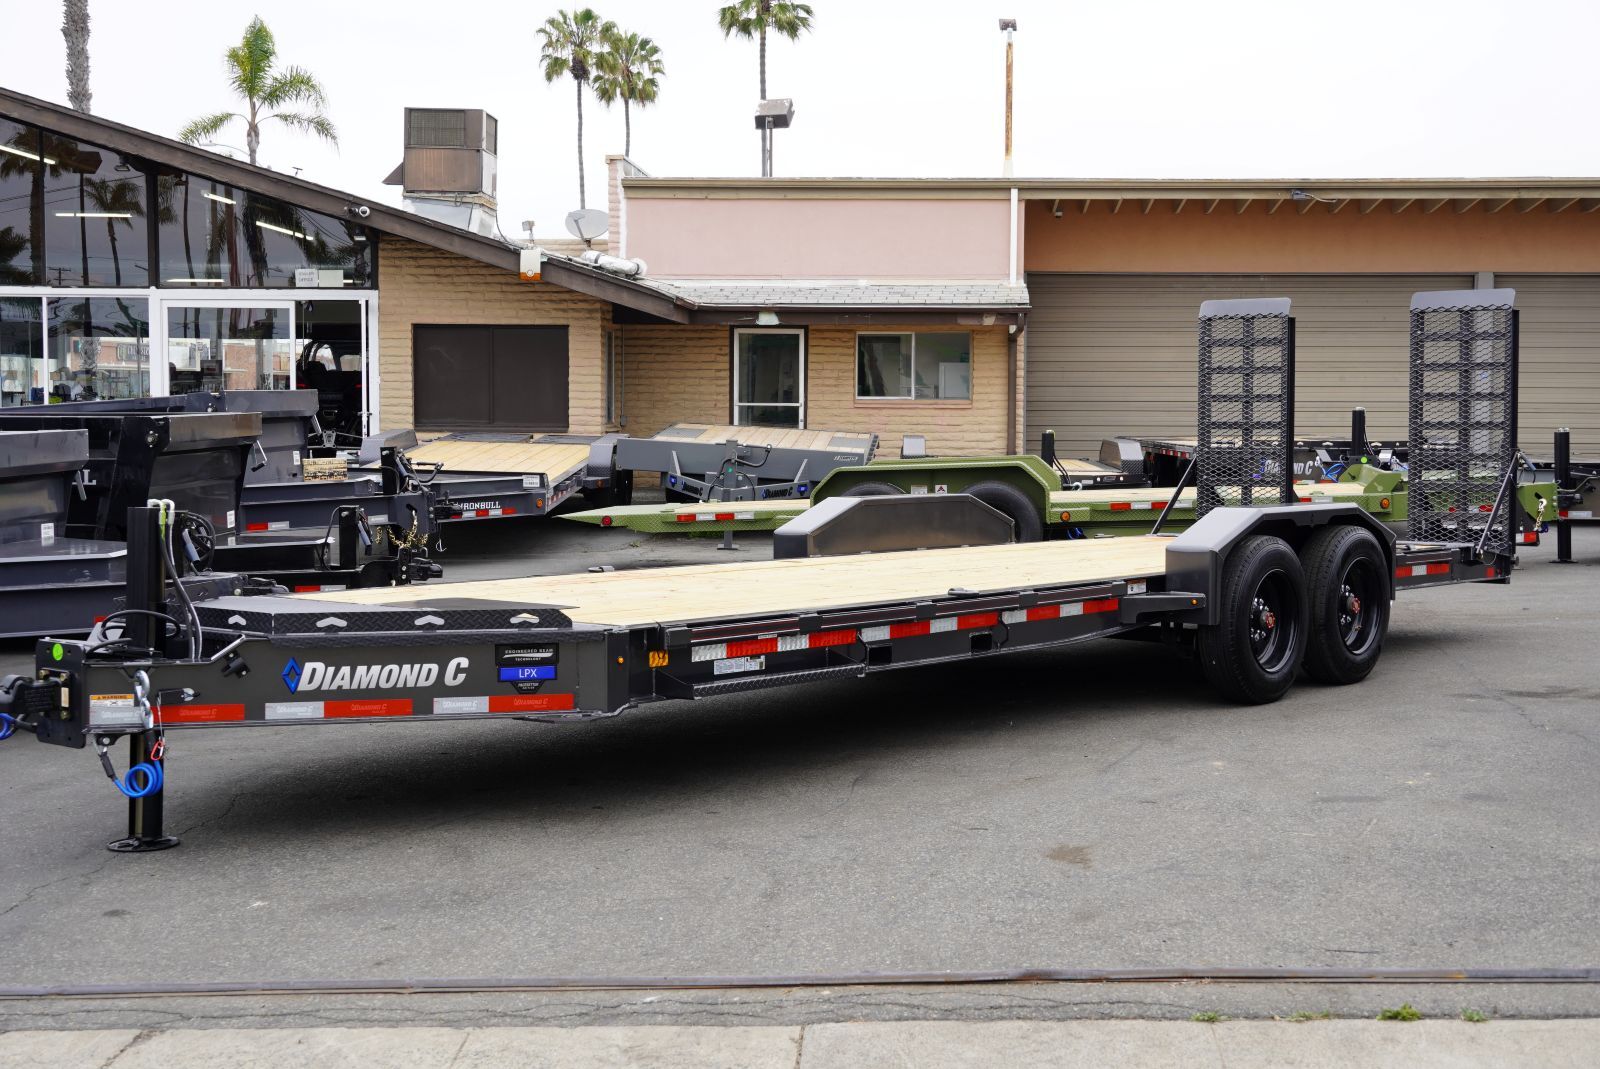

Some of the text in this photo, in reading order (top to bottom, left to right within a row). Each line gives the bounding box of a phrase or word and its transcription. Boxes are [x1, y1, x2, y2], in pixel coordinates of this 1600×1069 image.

[1304, 460, 1314, 475] C
[297, 656, 469, 691] DIAMOND C
[518, 668, 538, 678] LPX
